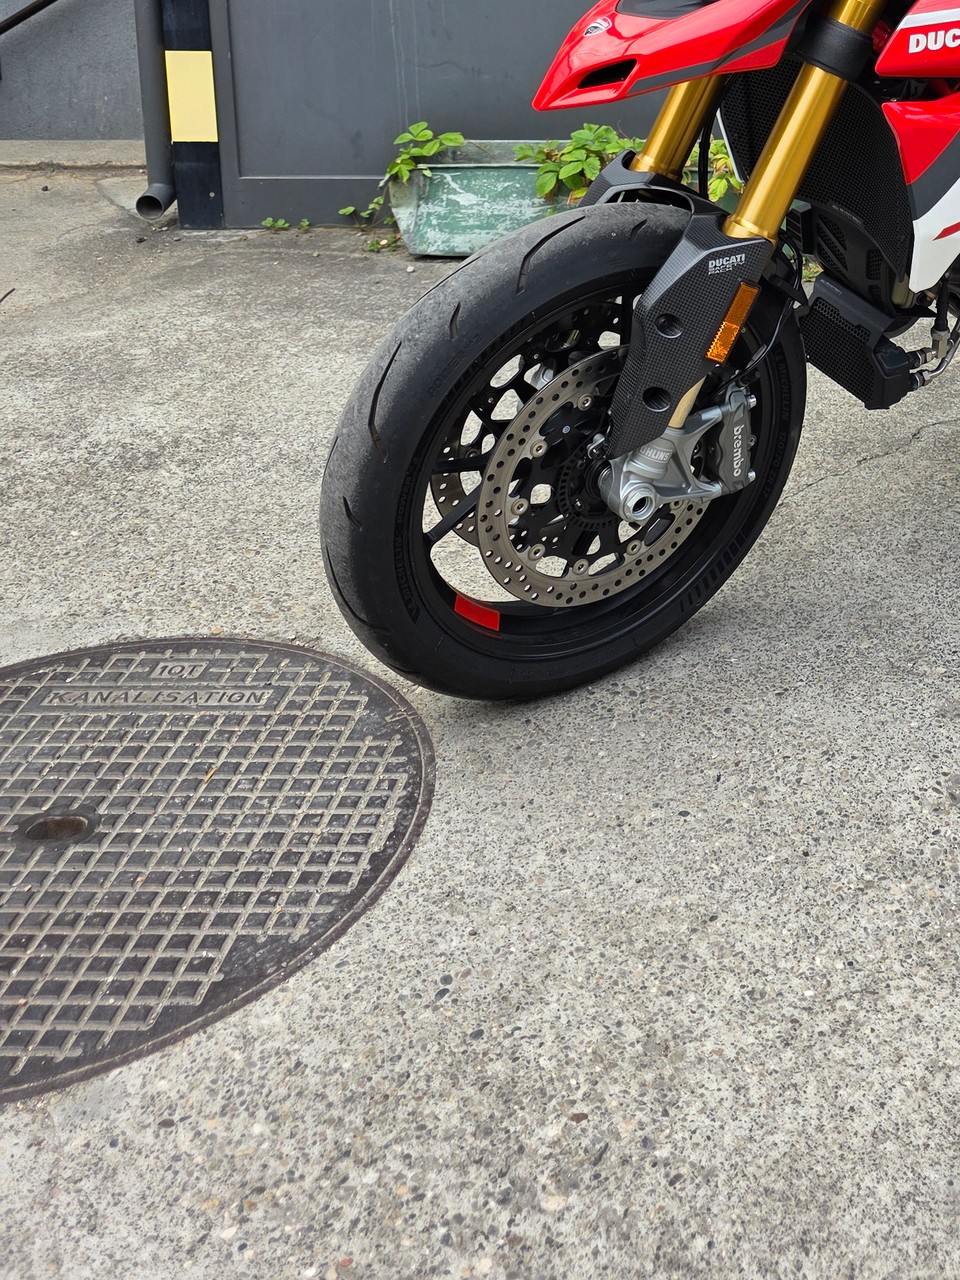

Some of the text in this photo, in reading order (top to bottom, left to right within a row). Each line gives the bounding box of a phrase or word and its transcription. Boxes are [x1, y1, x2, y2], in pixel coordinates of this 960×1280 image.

[708, 253, 746, 268] DUCATI
[732, 424, 745, 478] brembo
[157, 663, 204, 677] 10T
[49, 690, 264, 705] KANALISATION
